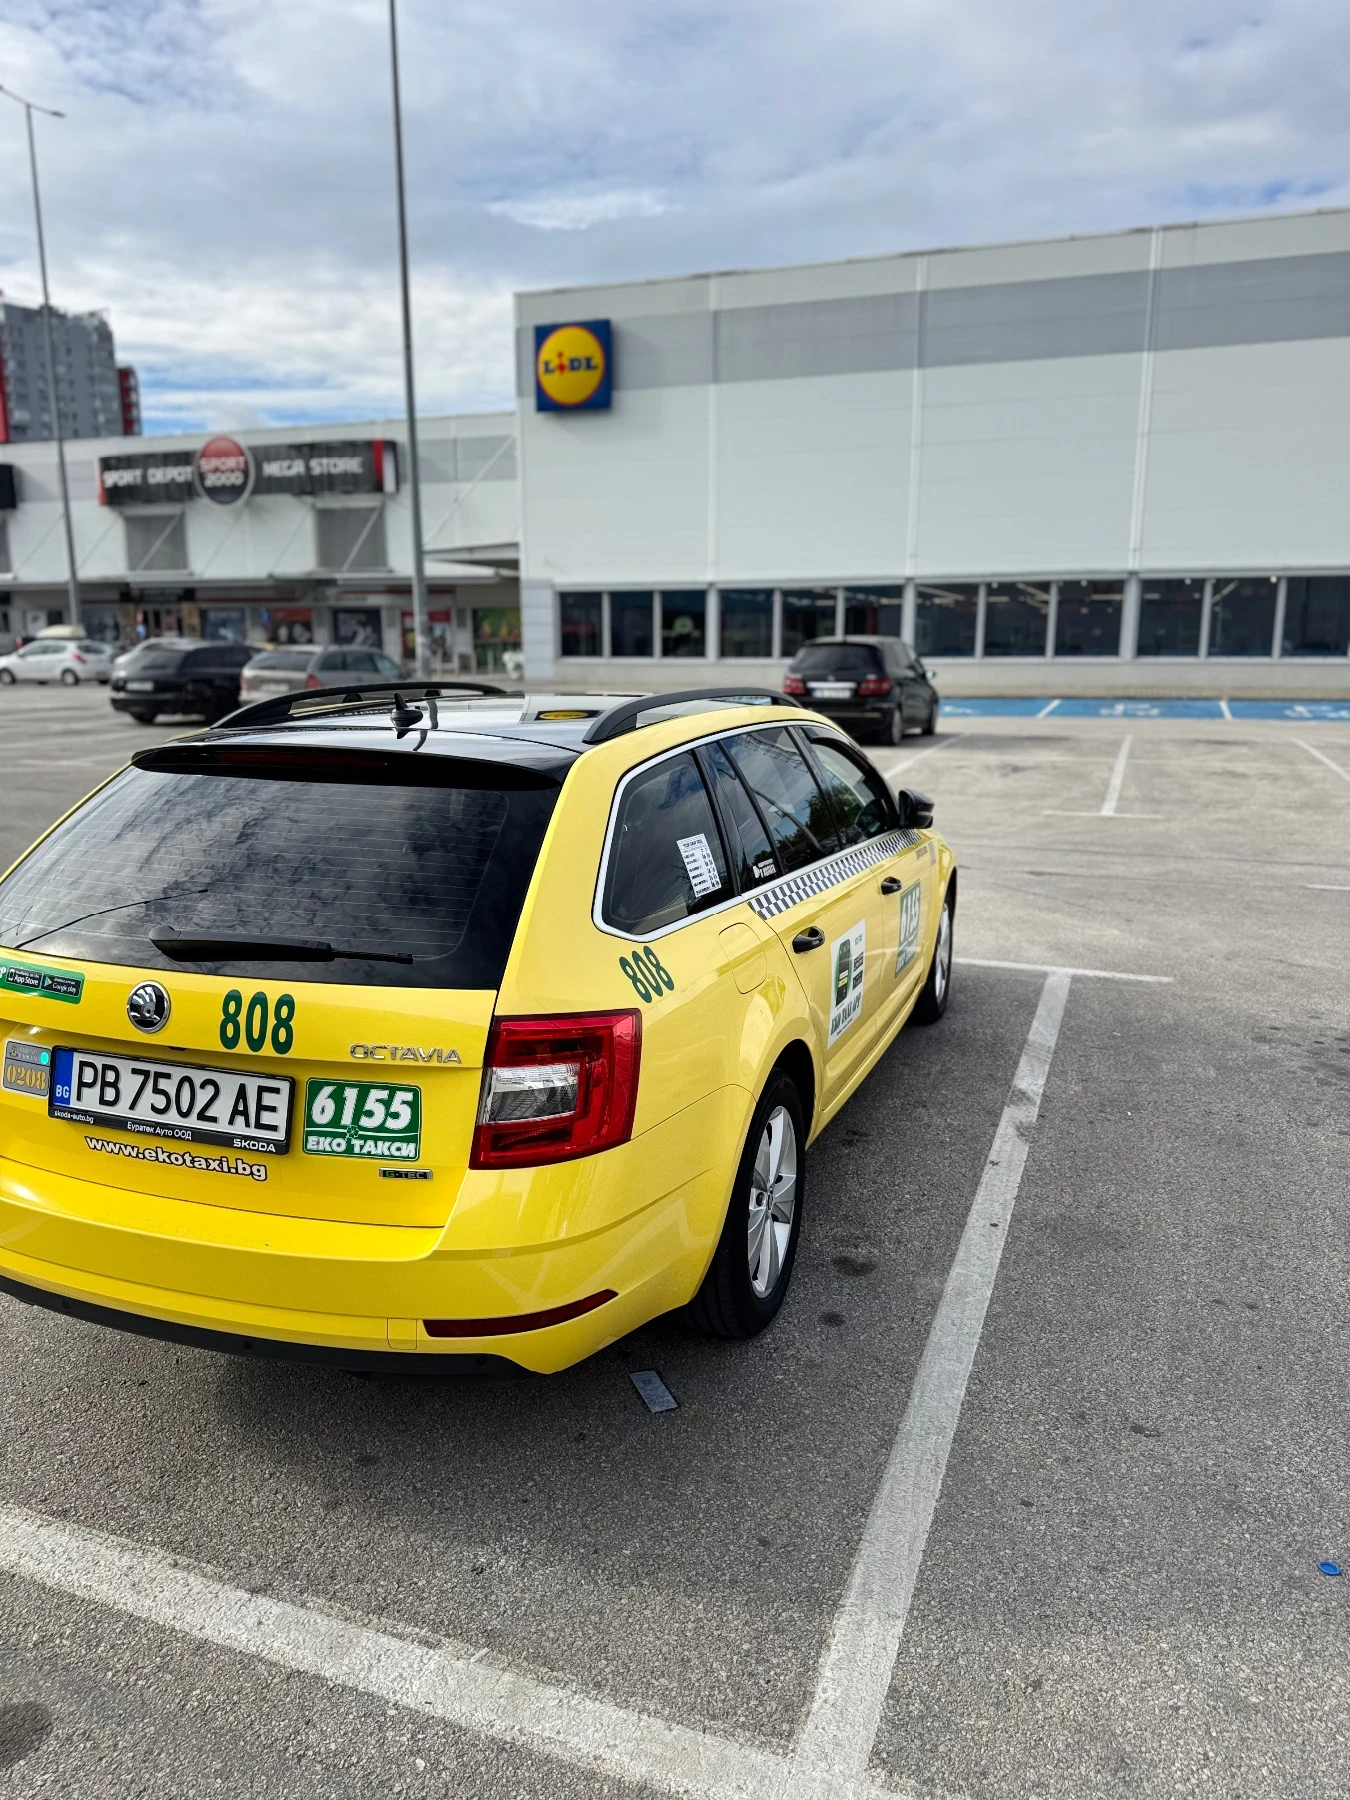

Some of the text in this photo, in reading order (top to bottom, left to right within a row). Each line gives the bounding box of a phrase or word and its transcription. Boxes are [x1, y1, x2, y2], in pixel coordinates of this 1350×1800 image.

[200, 456, 246, 471] SPORT
[262, 456, 363, 477] MEGA STORE
[103, 466, 193, 488] SPORT DEPOT
[203, 470, 244, 487] 2000
[14, 974, 39, 985] App Store
[619, 945, 675, 1004] 808
[52, 982, 67, 993] Google
[219, 989, 295, 1054] 808
[350, 1044, 462, 1064] OCTAVIA
[6, 1064, 47, 1090] 0208
[55, 1084, 70, 1098] BG
[76, 1060, 281, 1132] PB 7502 AE
[54, 1109, 94, 1124] skoda-auto.bg
[311, 1085, 414, 1131] 6155
[127, 1121, 192, 1140] Еуратек Ауто ООД
[233, 1138, 276, 1153] SKODA
[306, 1135, 416, 1157] ЕКО ТАКСИ
[84, 1135, 268, 1181] www.ekotaxi.bg
[385, 1170, 425, 1179] G-TEC
